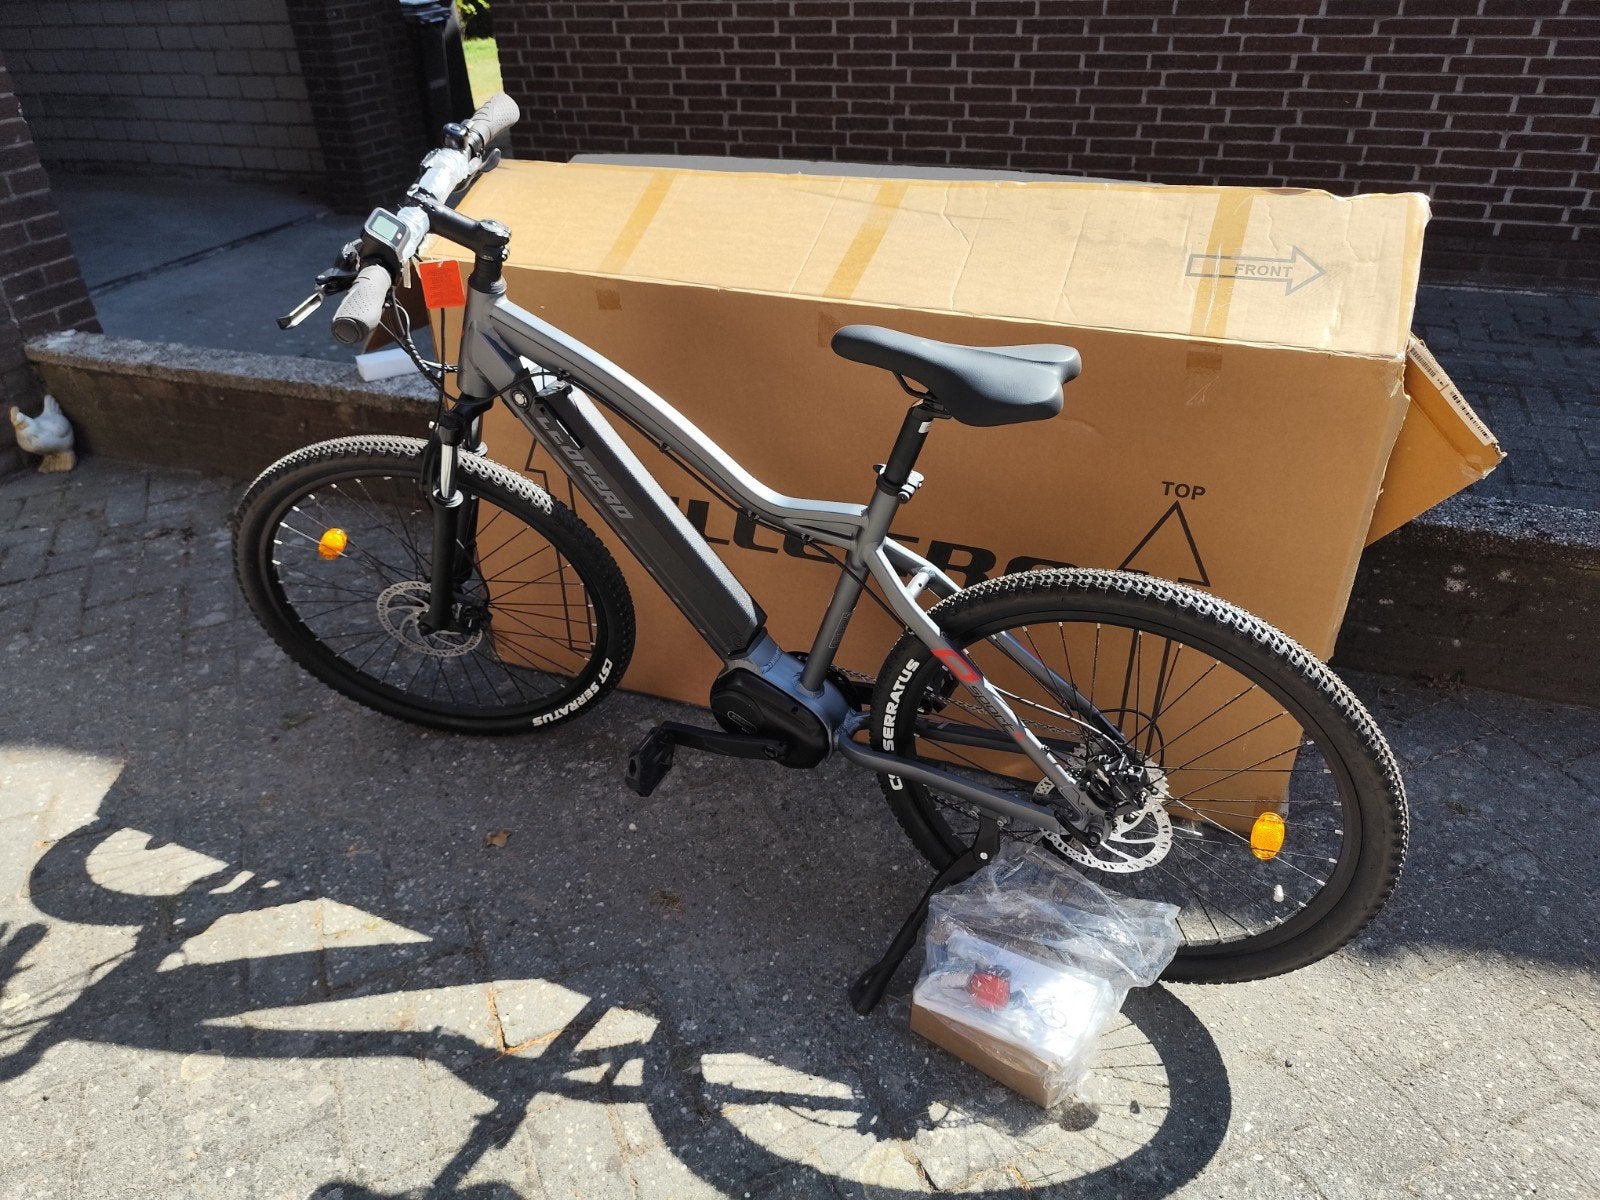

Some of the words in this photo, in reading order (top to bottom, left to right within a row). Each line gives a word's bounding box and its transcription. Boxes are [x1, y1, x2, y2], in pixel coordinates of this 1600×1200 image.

[1235, 263, 1293, 278] FRONT
[1162, 480, 1206, 500] TOP
[532, 681, 600, 727] SERRATUS
[882, 658, 920, 751] SERRATUS
